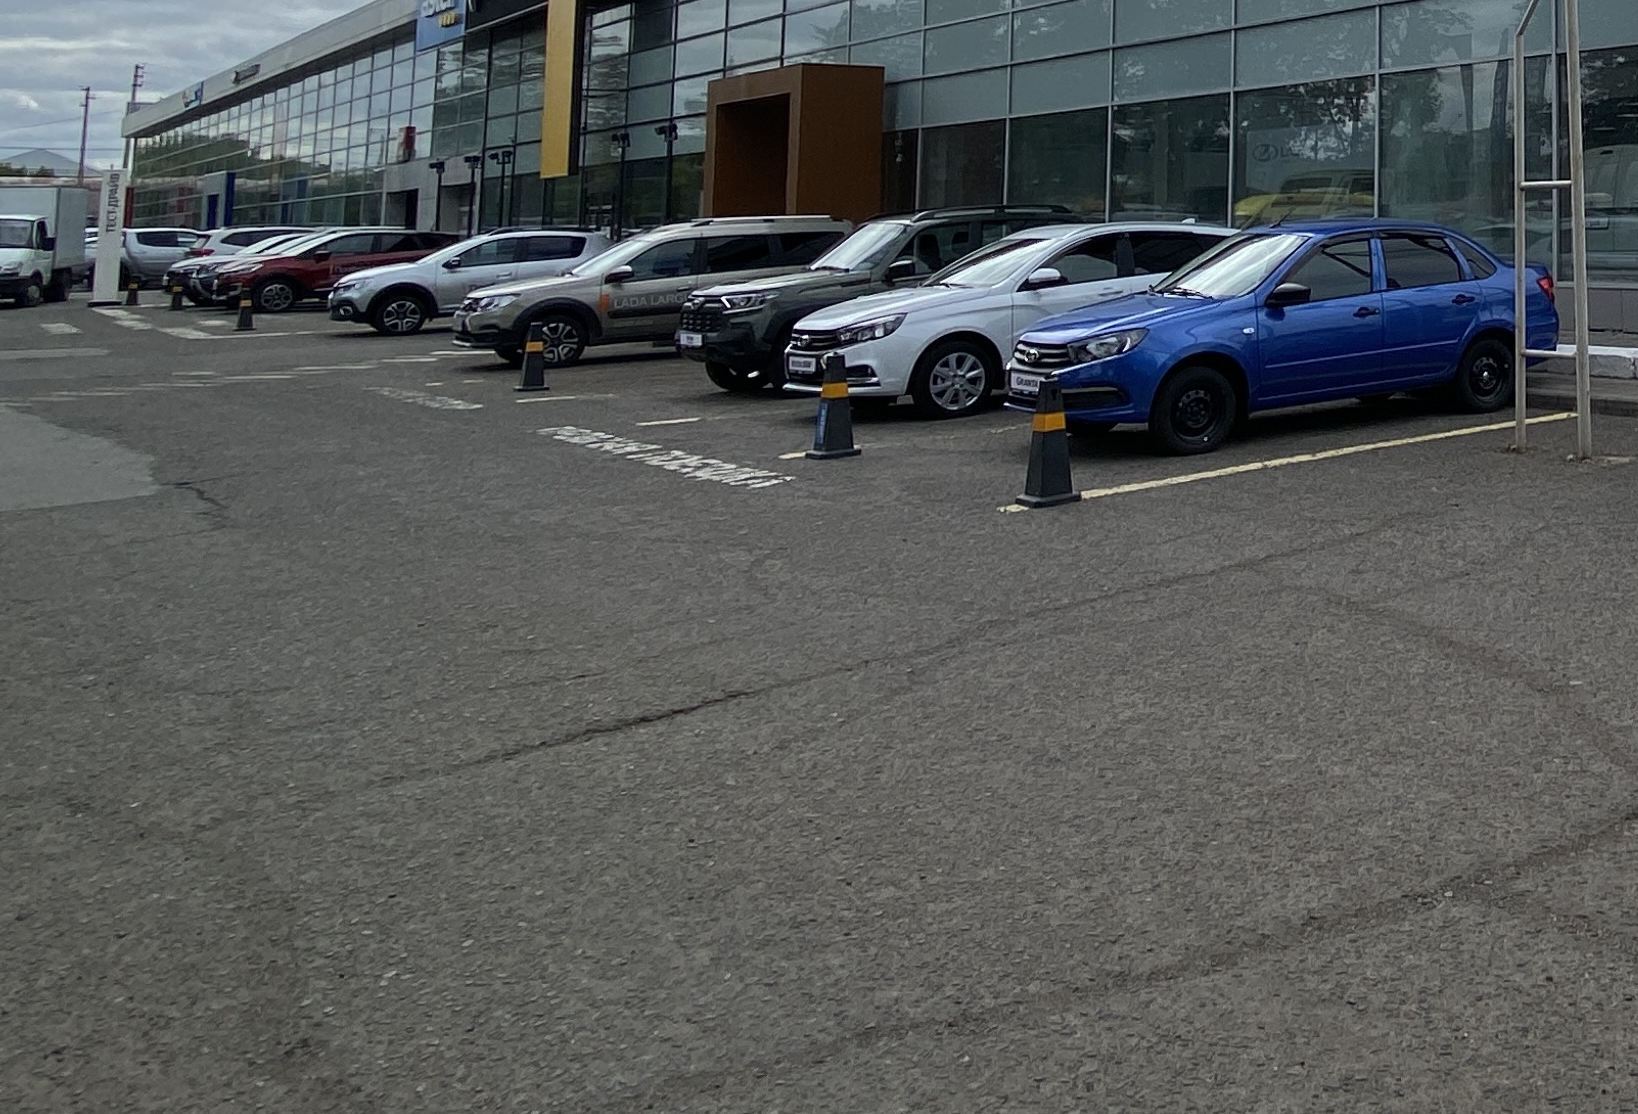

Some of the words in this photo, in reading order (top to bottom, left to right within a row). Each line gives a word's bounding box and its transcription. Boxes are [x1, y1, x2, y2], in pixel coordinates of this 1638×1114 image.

[106, 173, 120, 232] ТЕСТ-ДРАЙВ
[613, 296, 647, 309] LADA
[650, 293, 689, 306] LARG
